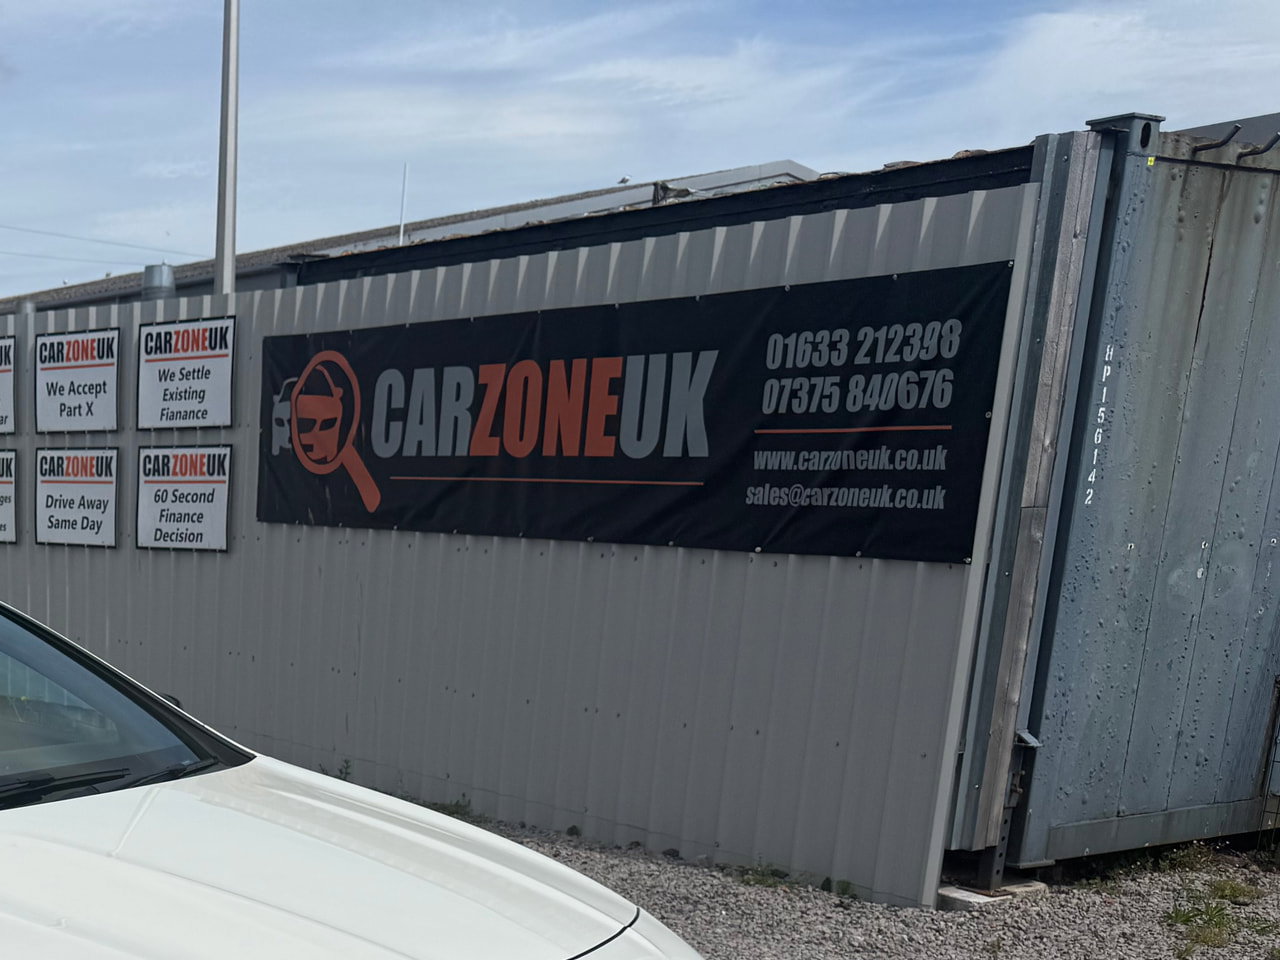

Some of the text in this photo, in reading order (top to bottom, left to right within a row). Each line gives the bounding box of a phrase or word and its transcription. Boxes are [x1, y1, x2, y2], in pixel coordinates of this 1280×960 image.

[39, 337, 115, 365] CARZONEUK
[144, 326, 230, 356] CARZONEUK
[766, 320, 963, 370] 01633 212398
[158, 366, 211, 382] We Settle
[46, 380, 108, 398] We Accept
[162, 387, 206, 404] Existing
[762, 370, 954, 415] 07375 840676
[59, 402, 95, 417] Part X
[160, 407, 209, 421] Fianance
[371, 350, 720, 460] CARZONEUK
[40, 455, 114, 478] CARZONEUK
[142, 453, 228, 477] CARZONEUK
[754, 445, 947, 473] www.carzoneuk.co.uk
[45, 494, 109, 513] Drive Away
[153, 489, 216, 504] 60 Second
[745, 483, 946, 511] sales@carzoneuk.co.uk
[47, 515, 103, 535] Same Day
[159, 509, 205, 523] Finance
[153, 529, 204, 543] Decision
